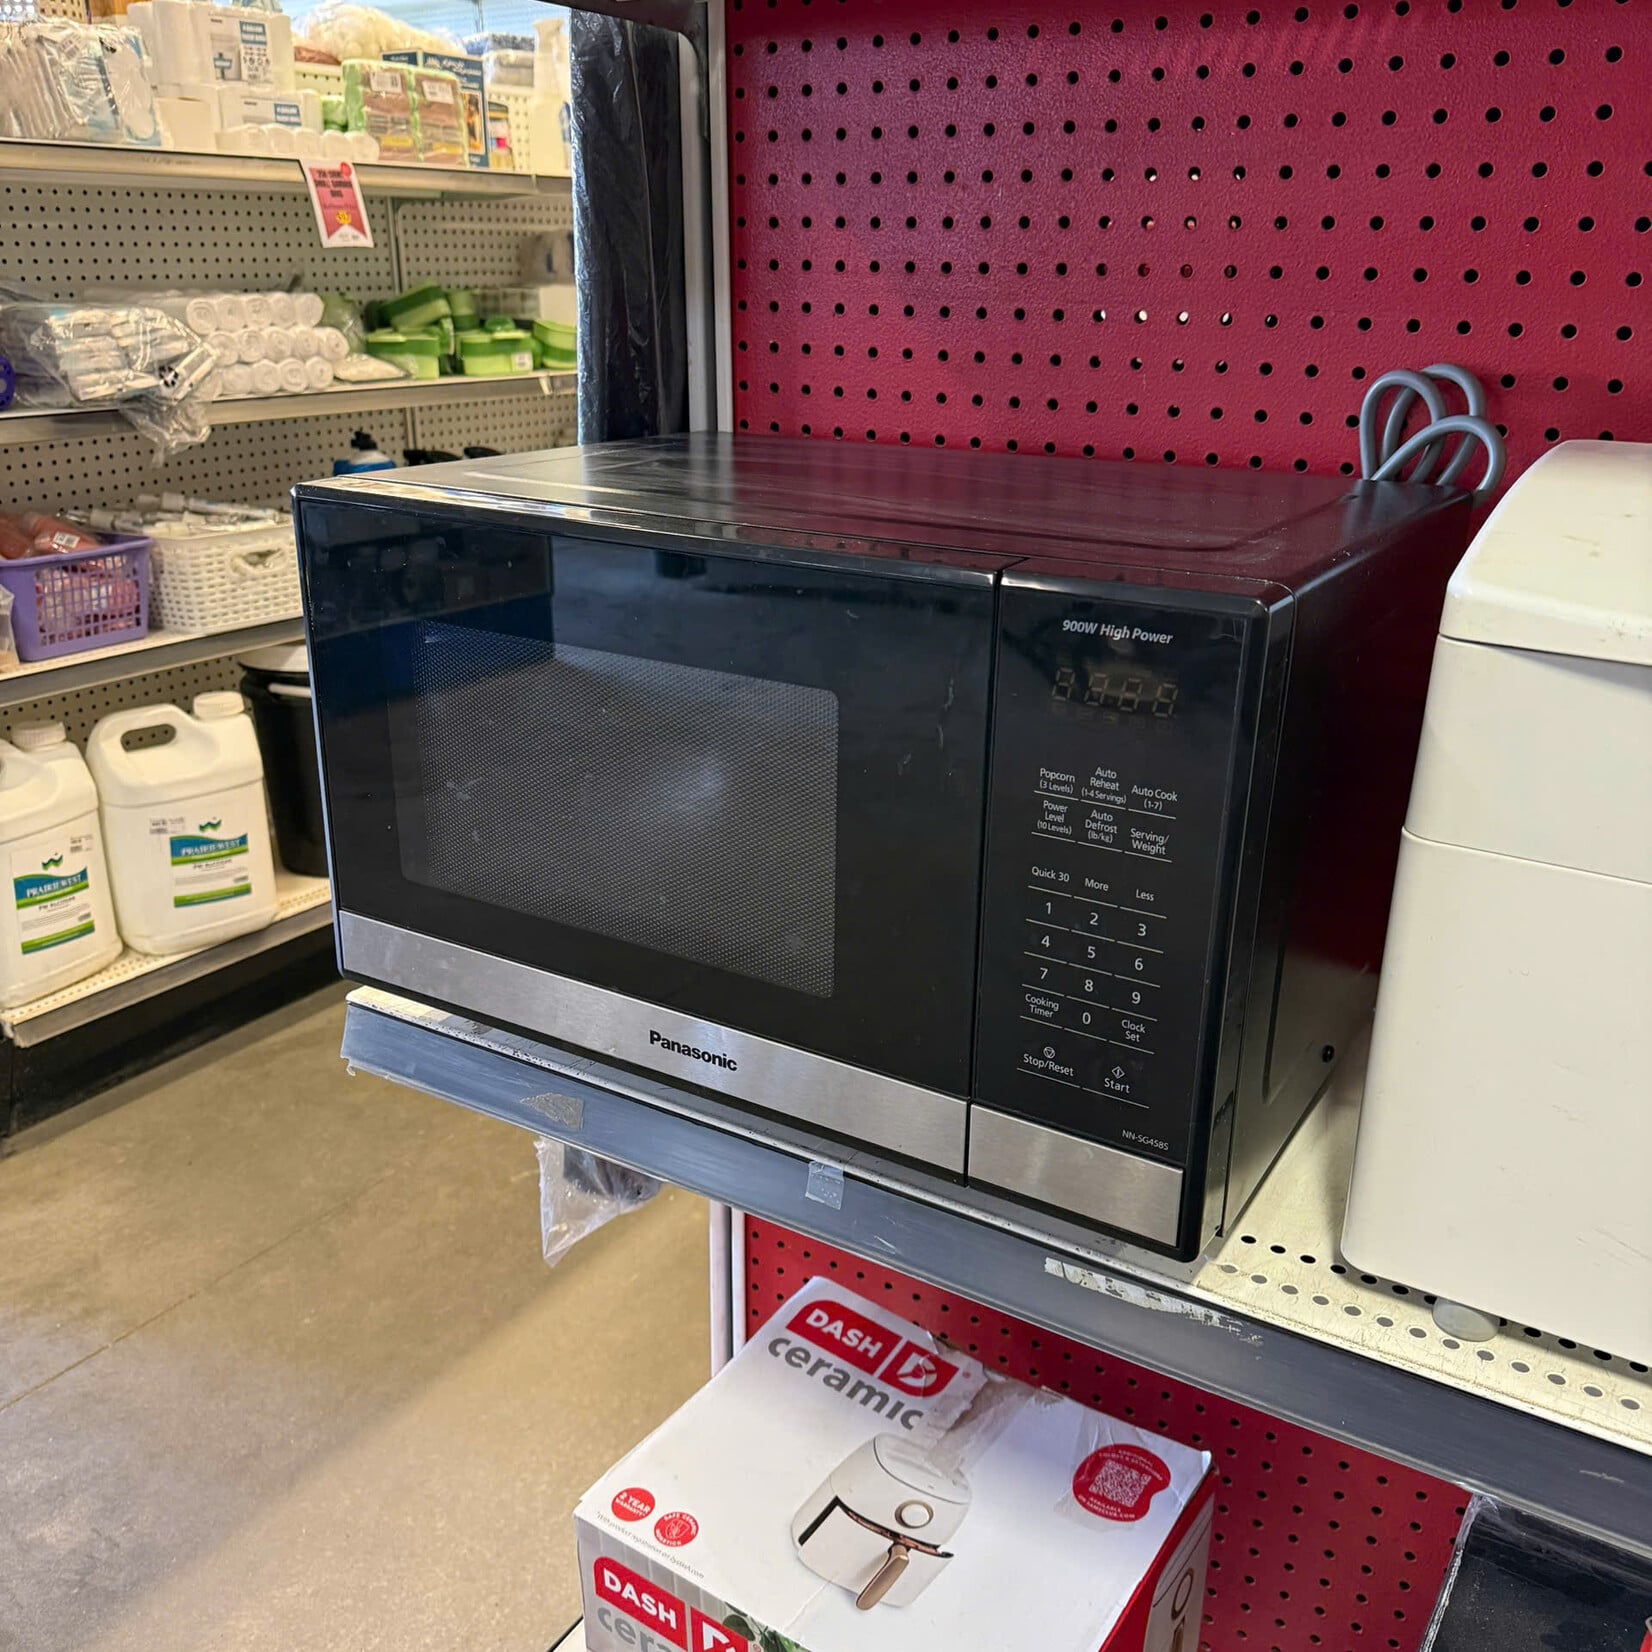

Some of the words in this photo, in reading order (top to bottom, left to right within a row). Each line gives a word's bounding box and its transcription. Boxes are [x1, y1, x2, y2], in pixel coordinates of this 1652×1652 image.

[1062, 619, 1098, 635] 900W
[1100, 623, 1130, 641] High
[1132, 628, 1174, 644] Power
[1040, 768, 1075, 783] Popcorn
[1095, 767, 1117, 779] Auto
[1039, 779, 1048, 789] (3
[1049, 782, 1074, 794] Levels)
[1090, 777, 1120, 791] Reheat
[1081, 787, 1094, 798] (1-4
[1095, 790, 1127, 805] Servings)
[1131, 785, 1153, 797] Auto
[1155, 789, 1178, 802] Cook
[1043, 800, 1068, 813] Power
[1144, 799, 1163, 811] (1-7)
[1045, 811, 1065, 823] Level
[1090, 810, 1113, 822] Auto
[1037, 820, 1047, 830] (10
[1048, 822, 1073, 836] Levels)
[1085, 820, 1118, 834] Defrost
[1088, 831, 1113, 844] (lb/kg)
[1130, 828, 1169, 846] Serving/
[1132, 839, 1166, 855] Weight
[1031, 866, 1056, 880] Quick
[1058, 872, 1070, 882] 30
[1085, 878, 1109, 892] More
[1136, 889, 1155, 901] Less
[1045, 902, 1052, 915] 1
[1089, 912, 1099, 926] 2
[1137, 923, 1147, 937] 3
[1040, 935, 1050, 948] 4
[1087, 946, 1096, 959] 5
[1134, 958, 1144, 971] 6
[1039, 967, 1049, 980] 7
[1084, 979, 1094, 992] 8
[1025, 993, 1060, 1012] Cooking
[1131, 991, 1141, 1005] 9
[1029, 1004, 1054, 1018] Timer
[1082, 1012, 1092, 1025] 0
[1121, 1019, 1146, 1034] Clock
[1125, 1030, 1140, 1043] Set
[649, 1029, 738, 1072] Panasonic
[1023, 1053, 1075, 1077] Stop/Reset
[1104, 1077, 1131, 1094] Start
[1122, 1129, 1169, 1151] NN-SG458S
[805, 1308, 883, 1358] DASH
[767, 1336, 925, 1431] ceramic
[627, 1495, 651, 1514] YEAR
[663, 1511, 680, 1522] SAFE
[603, 1567, 678, 1630] DASH
